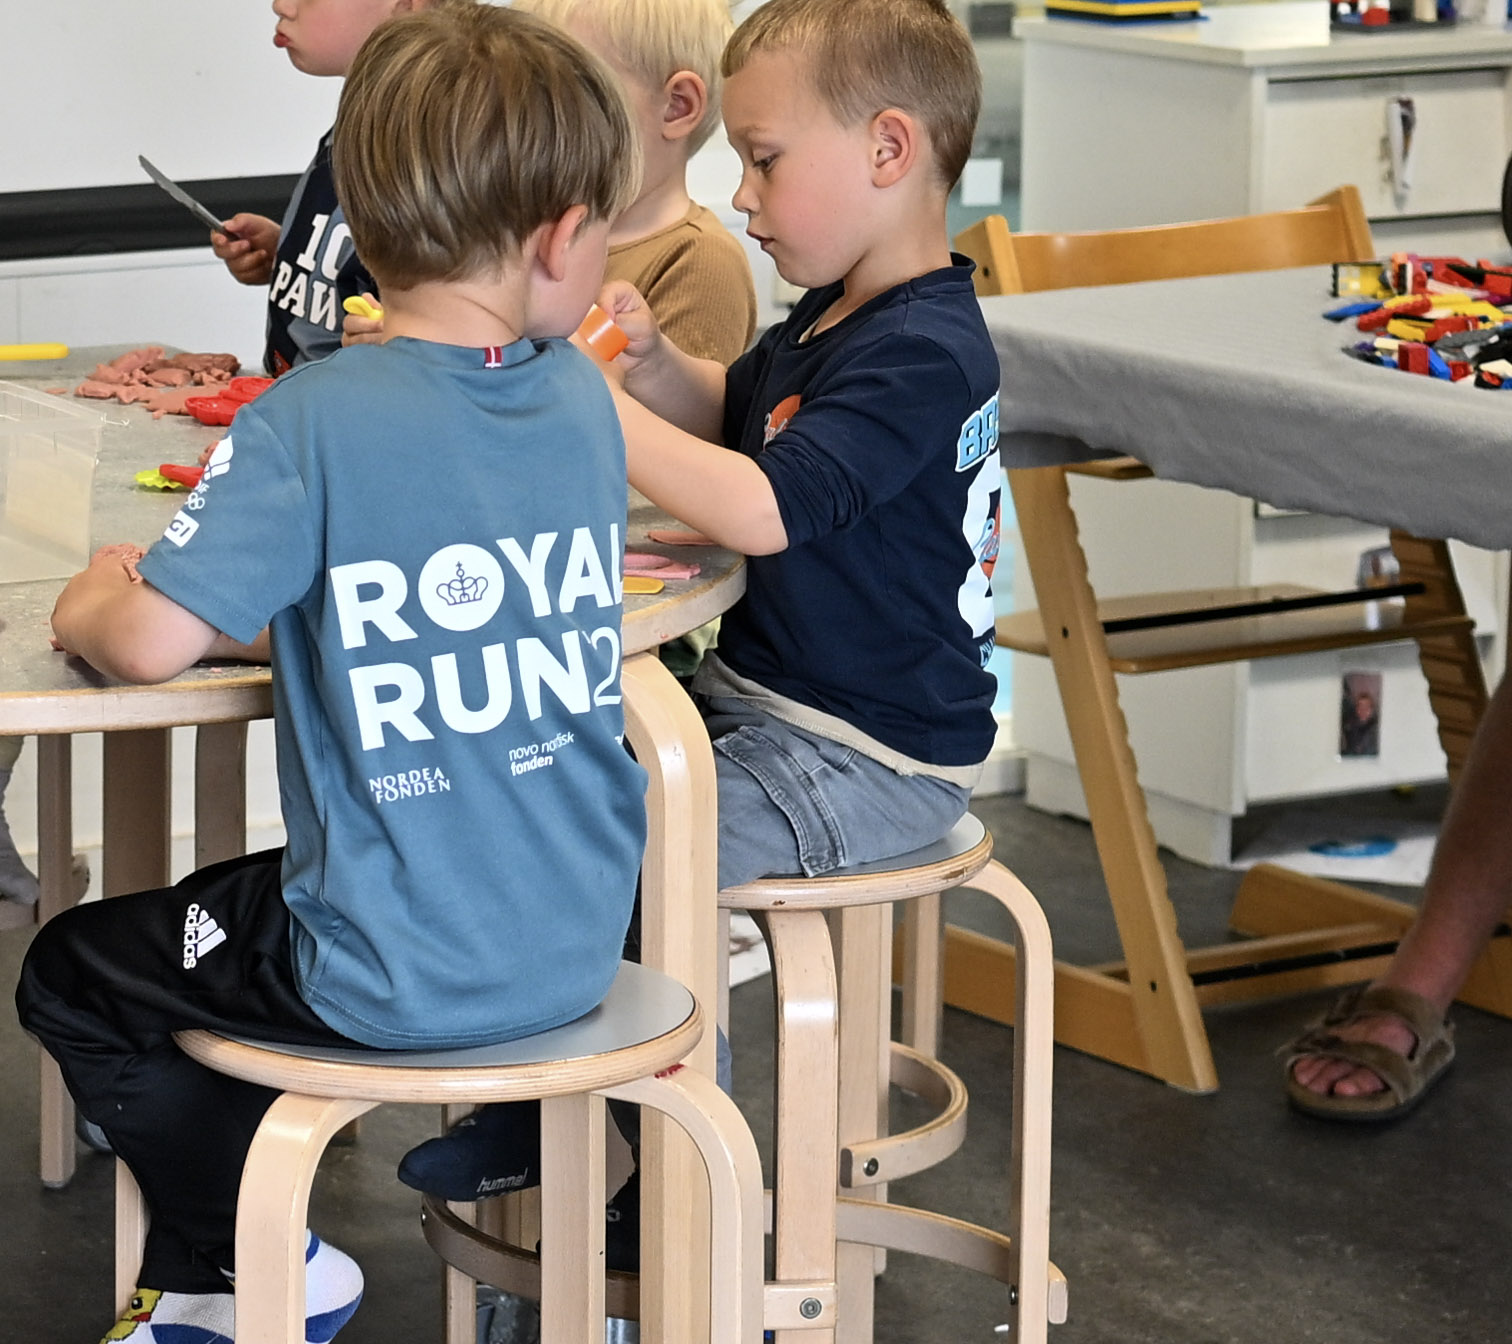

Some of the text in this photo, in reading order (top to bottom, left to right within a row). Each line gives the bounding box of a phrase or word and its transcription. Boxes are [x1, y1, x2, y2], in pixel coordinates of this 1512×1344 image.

[509, 743, 539, 761] novo
[510, 755, 553, 776] fonden
[369, 767, 445, 792] NORDEA
[376, 778, 451, 804] FONDEN
[183, 903, 200, 970] adidas
[476, 1167, 529, 1193] hummel
